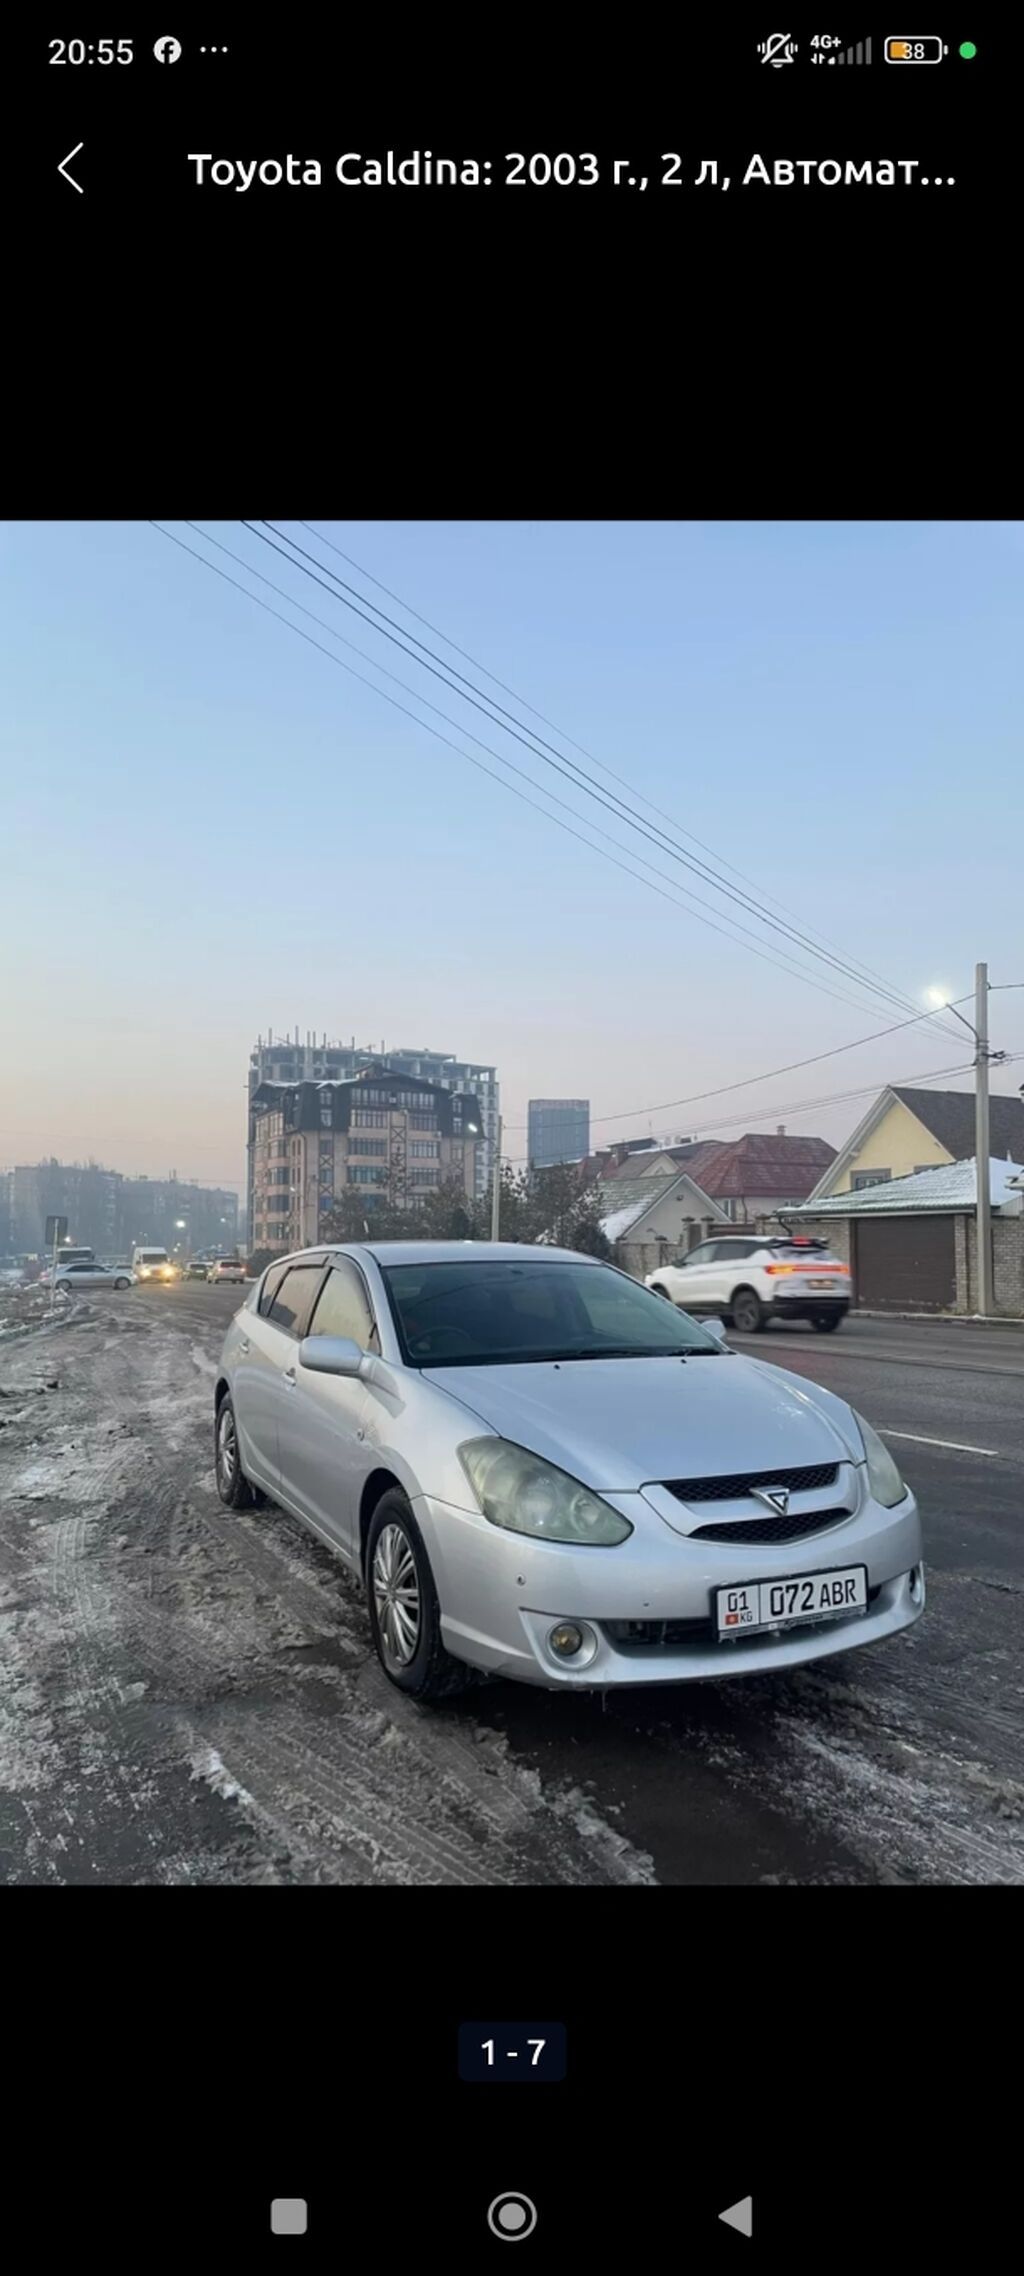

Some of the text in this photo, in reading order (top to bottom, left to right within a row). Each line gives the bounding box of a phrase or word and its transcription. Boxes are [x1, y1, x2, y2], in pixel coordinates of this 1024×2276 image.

[727, 1591, 749, 1612] 01
[770, 1578, 857, 1616] 072 ABR
[739, 1610, 753, 1623] KG
